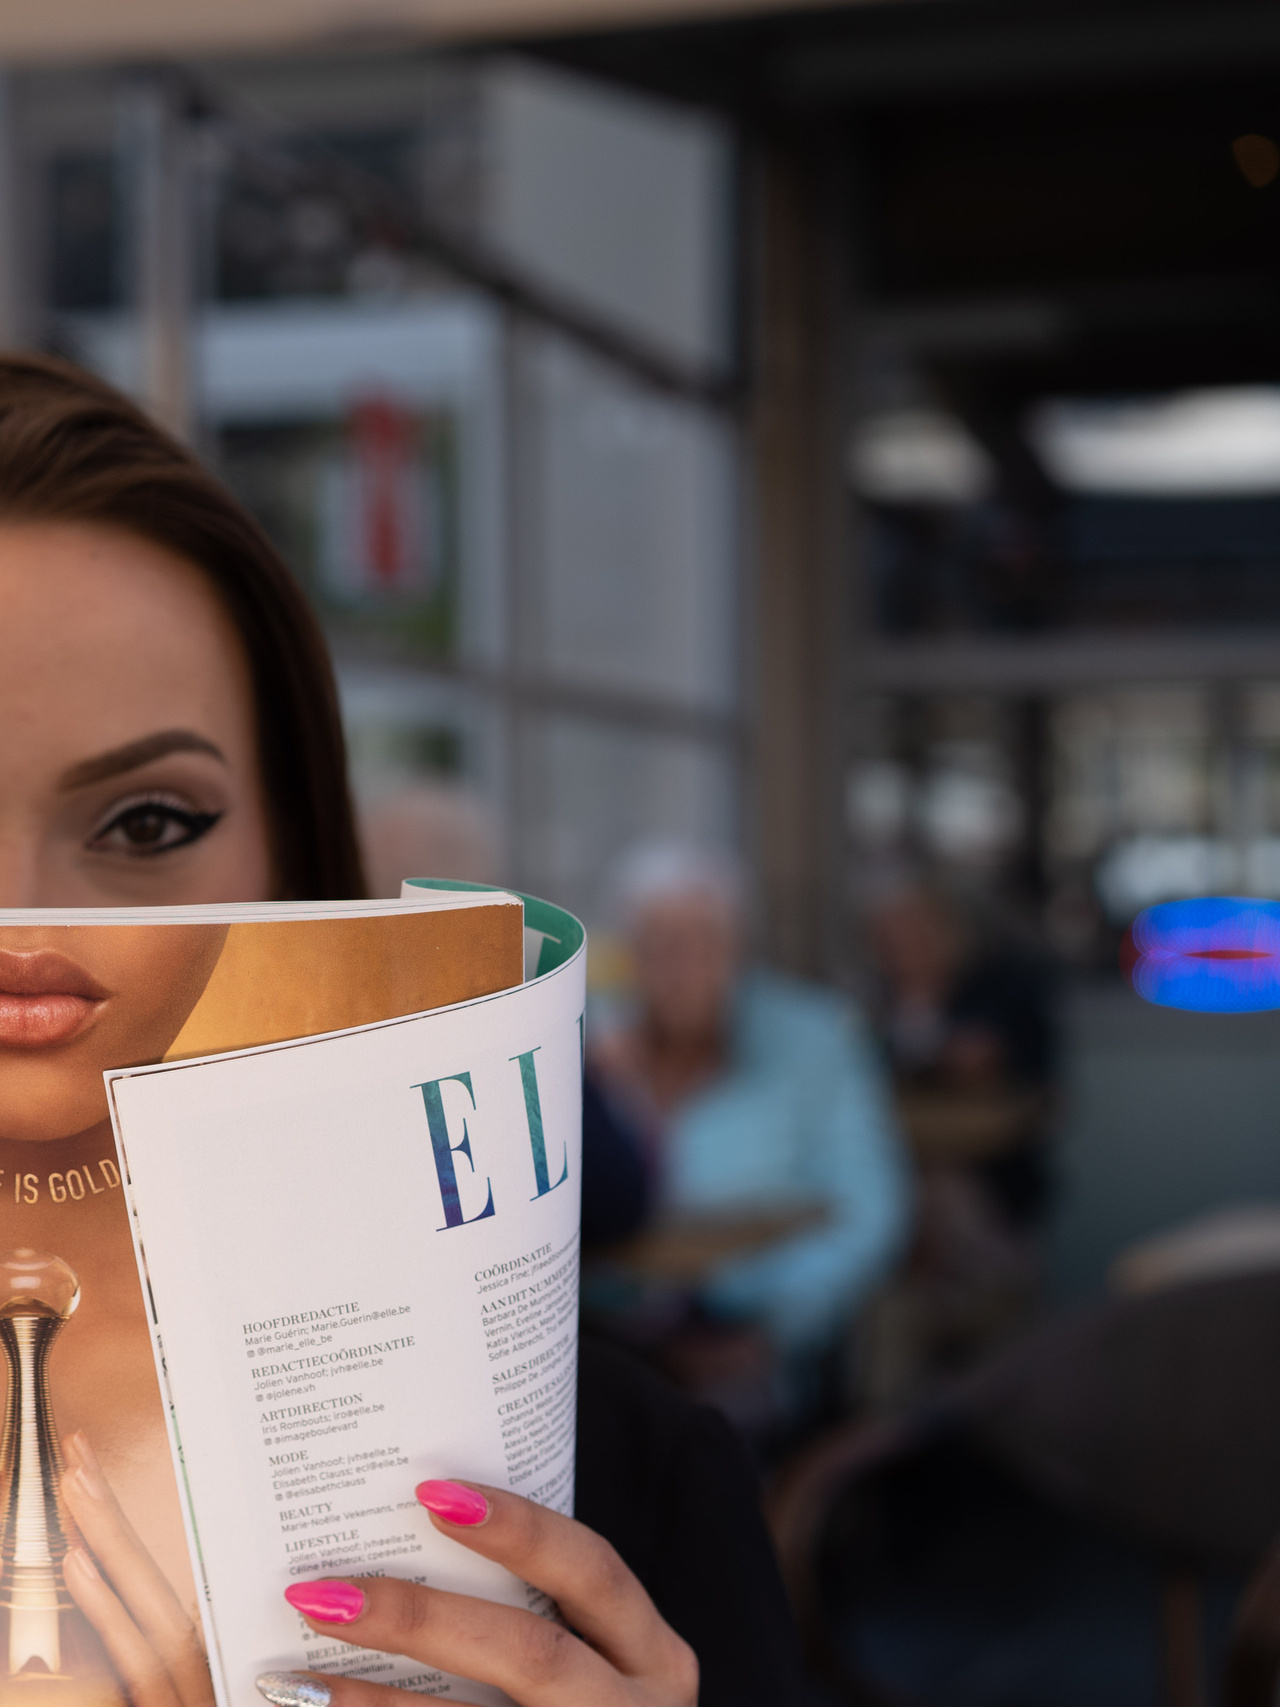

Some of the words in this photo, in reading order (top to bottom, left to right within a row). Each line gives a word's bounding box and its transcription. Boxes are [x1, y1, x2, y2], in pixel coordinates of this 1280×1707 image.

[15, 1172, 40, 1204] IS
[48, 1158, 120, 1203] GOLD
[477, 1278, 509, 1294] Jessica
[242, 1302, 360, 1334] HOOFDREDACTIE
[245, 1333, 272, 1346] Marie
[274, 1327, 309, 1342] Guérin;
[311, 1305, 411, 1333] Marie.Guerin@elle.be
[482, 1309, 516, 1327] Barbara
[257, 1334, 333, 1356] @marie_elle_be
[486, 1336, 509, 1350] Katia
[251, 1335, 416, 1379] REDACTIECOÖRDINATIE
[488, 1349, 510, 1362] Sofie
[254, 1378, 283, 1391] Jolien
[285, 1368, 329, 1385] Vanhoof;
[260, 1393, 363, 1423] ARTDIRECTION
[262, 1424, 278, 1434] Iris
[274, 1420, 358, 1445] @imageboulevard
[268, 1450, 309, 1467] MODE
[271, 1466, 300, 1479] Jolien
[273, 1475, 317, 1490] Elisabeth
[279, 1502, 333, 1522] BEAUTY
[285, 1529, 360, 1553] LIFESTYLE
[288, 1551, 317, 1564] Jolien
[289, 1560, 320, 1576] Céline
